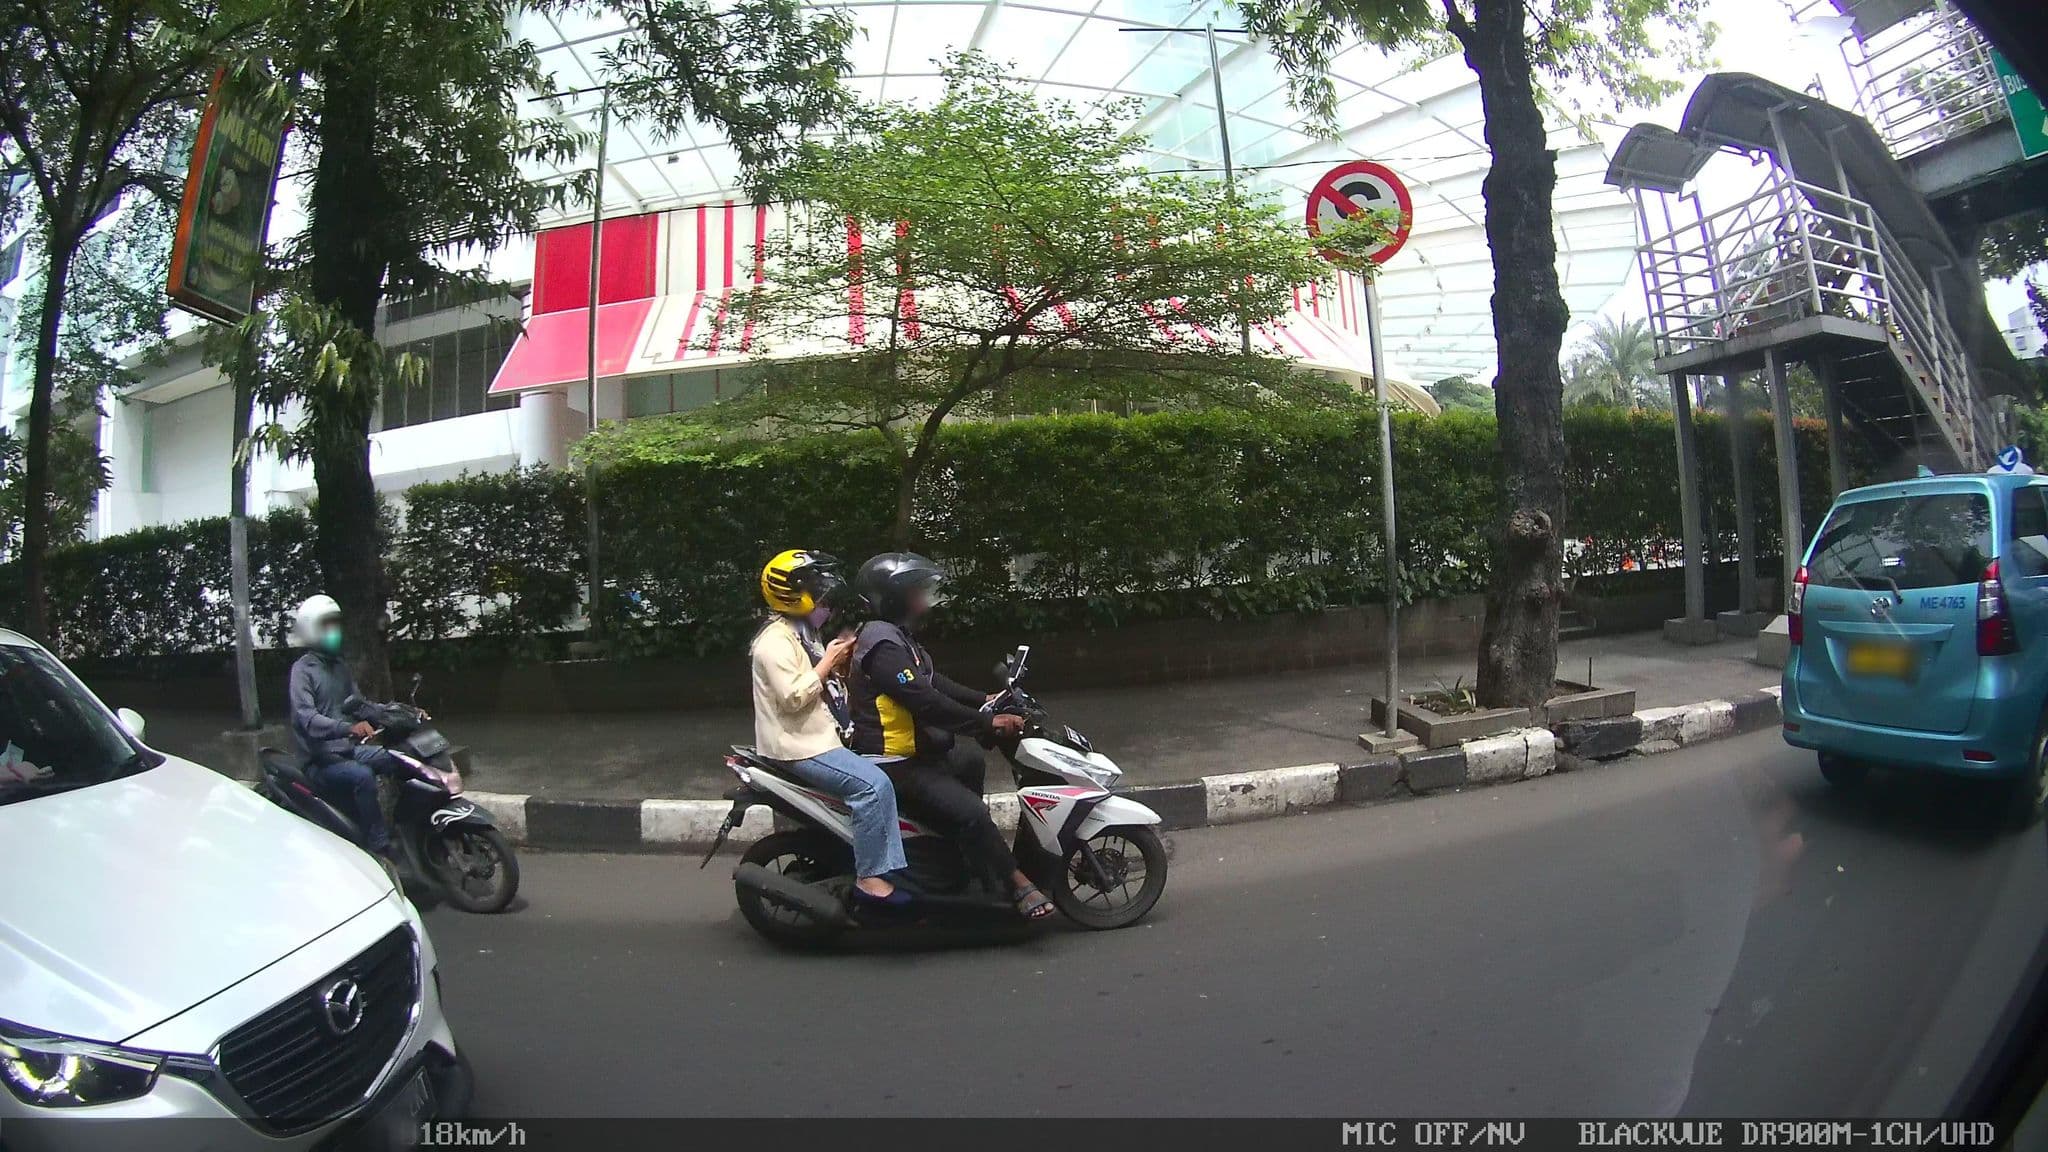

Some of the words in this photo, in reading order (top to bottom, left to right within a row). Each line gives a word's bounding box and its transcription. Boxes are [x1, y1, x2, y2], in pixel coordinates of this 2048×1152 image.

[1920, 596, 1966, 609] ME4763
[896, 668, 915, 684] 83
[1031, 791, 1061, 800] HONDA
